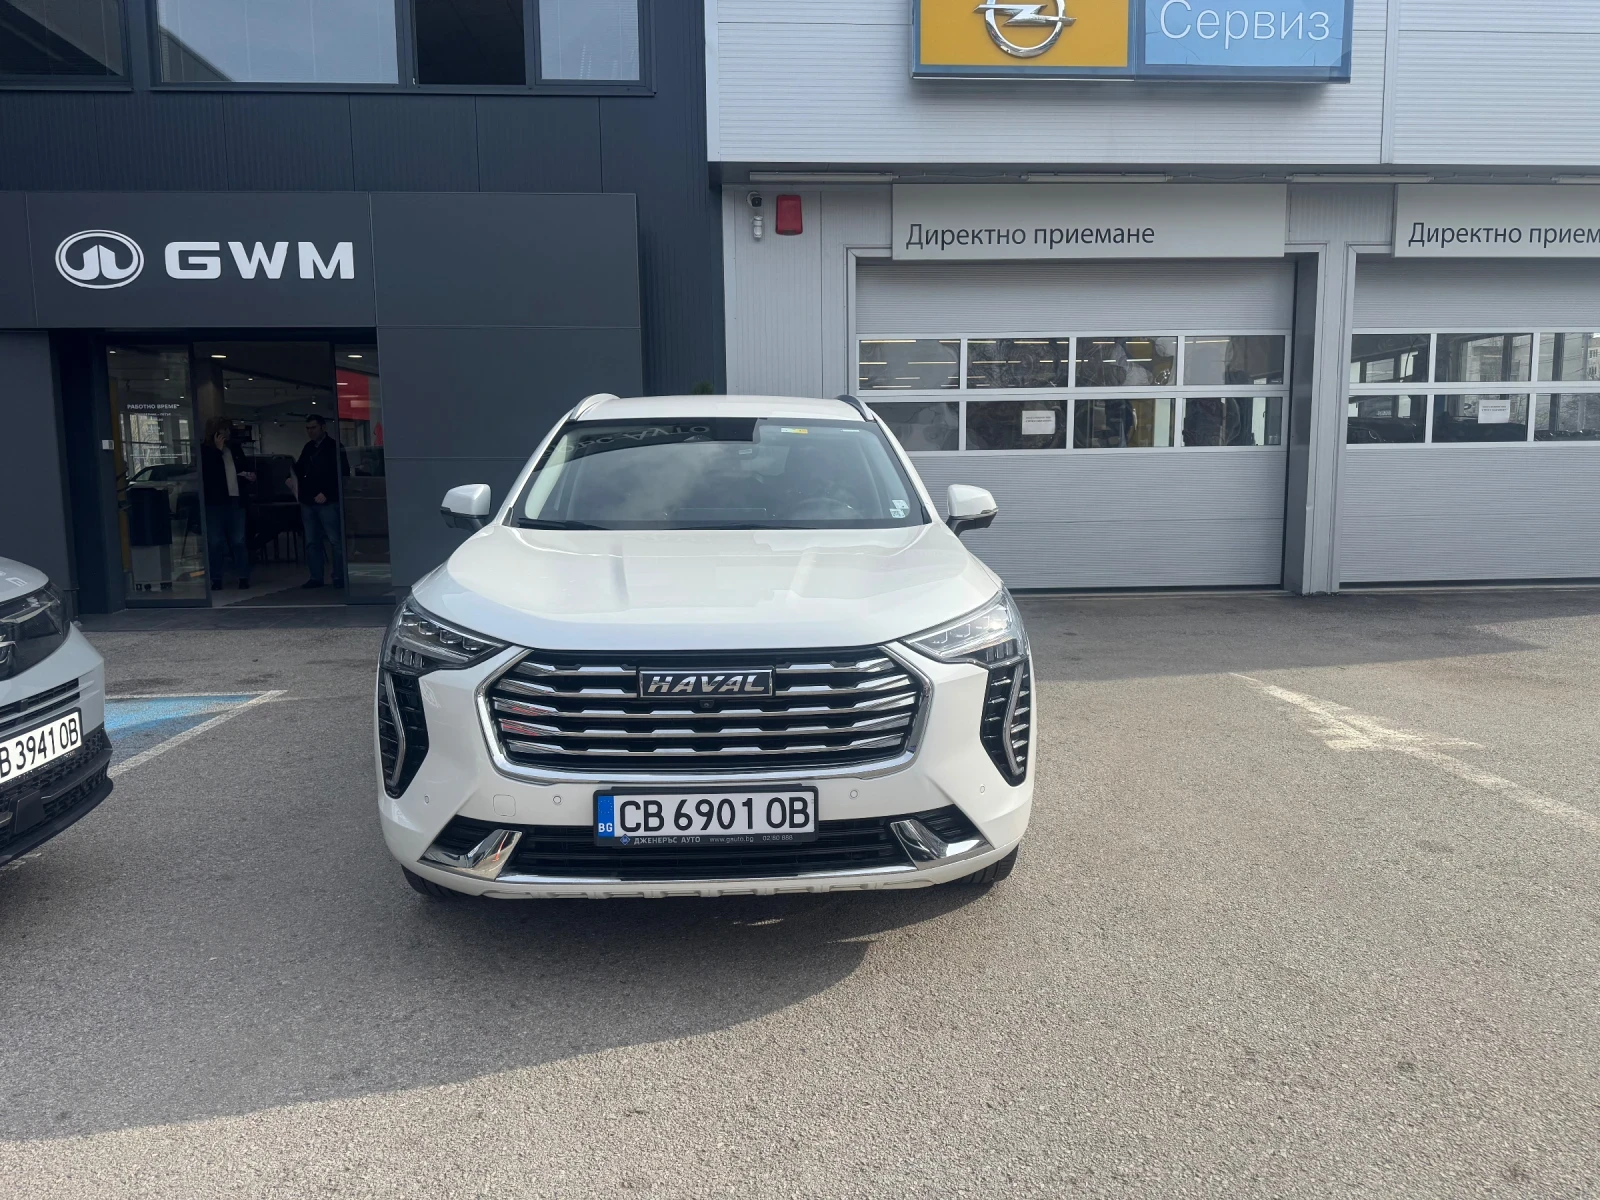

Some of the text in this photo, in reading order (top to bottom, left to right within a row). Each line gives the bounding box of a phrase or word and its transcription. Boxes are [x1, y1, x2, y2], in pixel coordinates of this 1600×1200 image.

[1160, 0, 1330, 50] Сервиз
[905, 223, 1155, 250] Директно приемане
[1408, 222, 1522, 249] Директно
[164, 241, 355, 279] GWM
[647, 675, 765, 693] HAVAL
[15, 726, 56, 771] 3941
[598, 822, 613, 833] BG
[619, 799, 665, 833] CB
[673, 796, 754, 832] 6901
[633, 835, 701, 845] ДЖЕНЕРЪС АУТО
